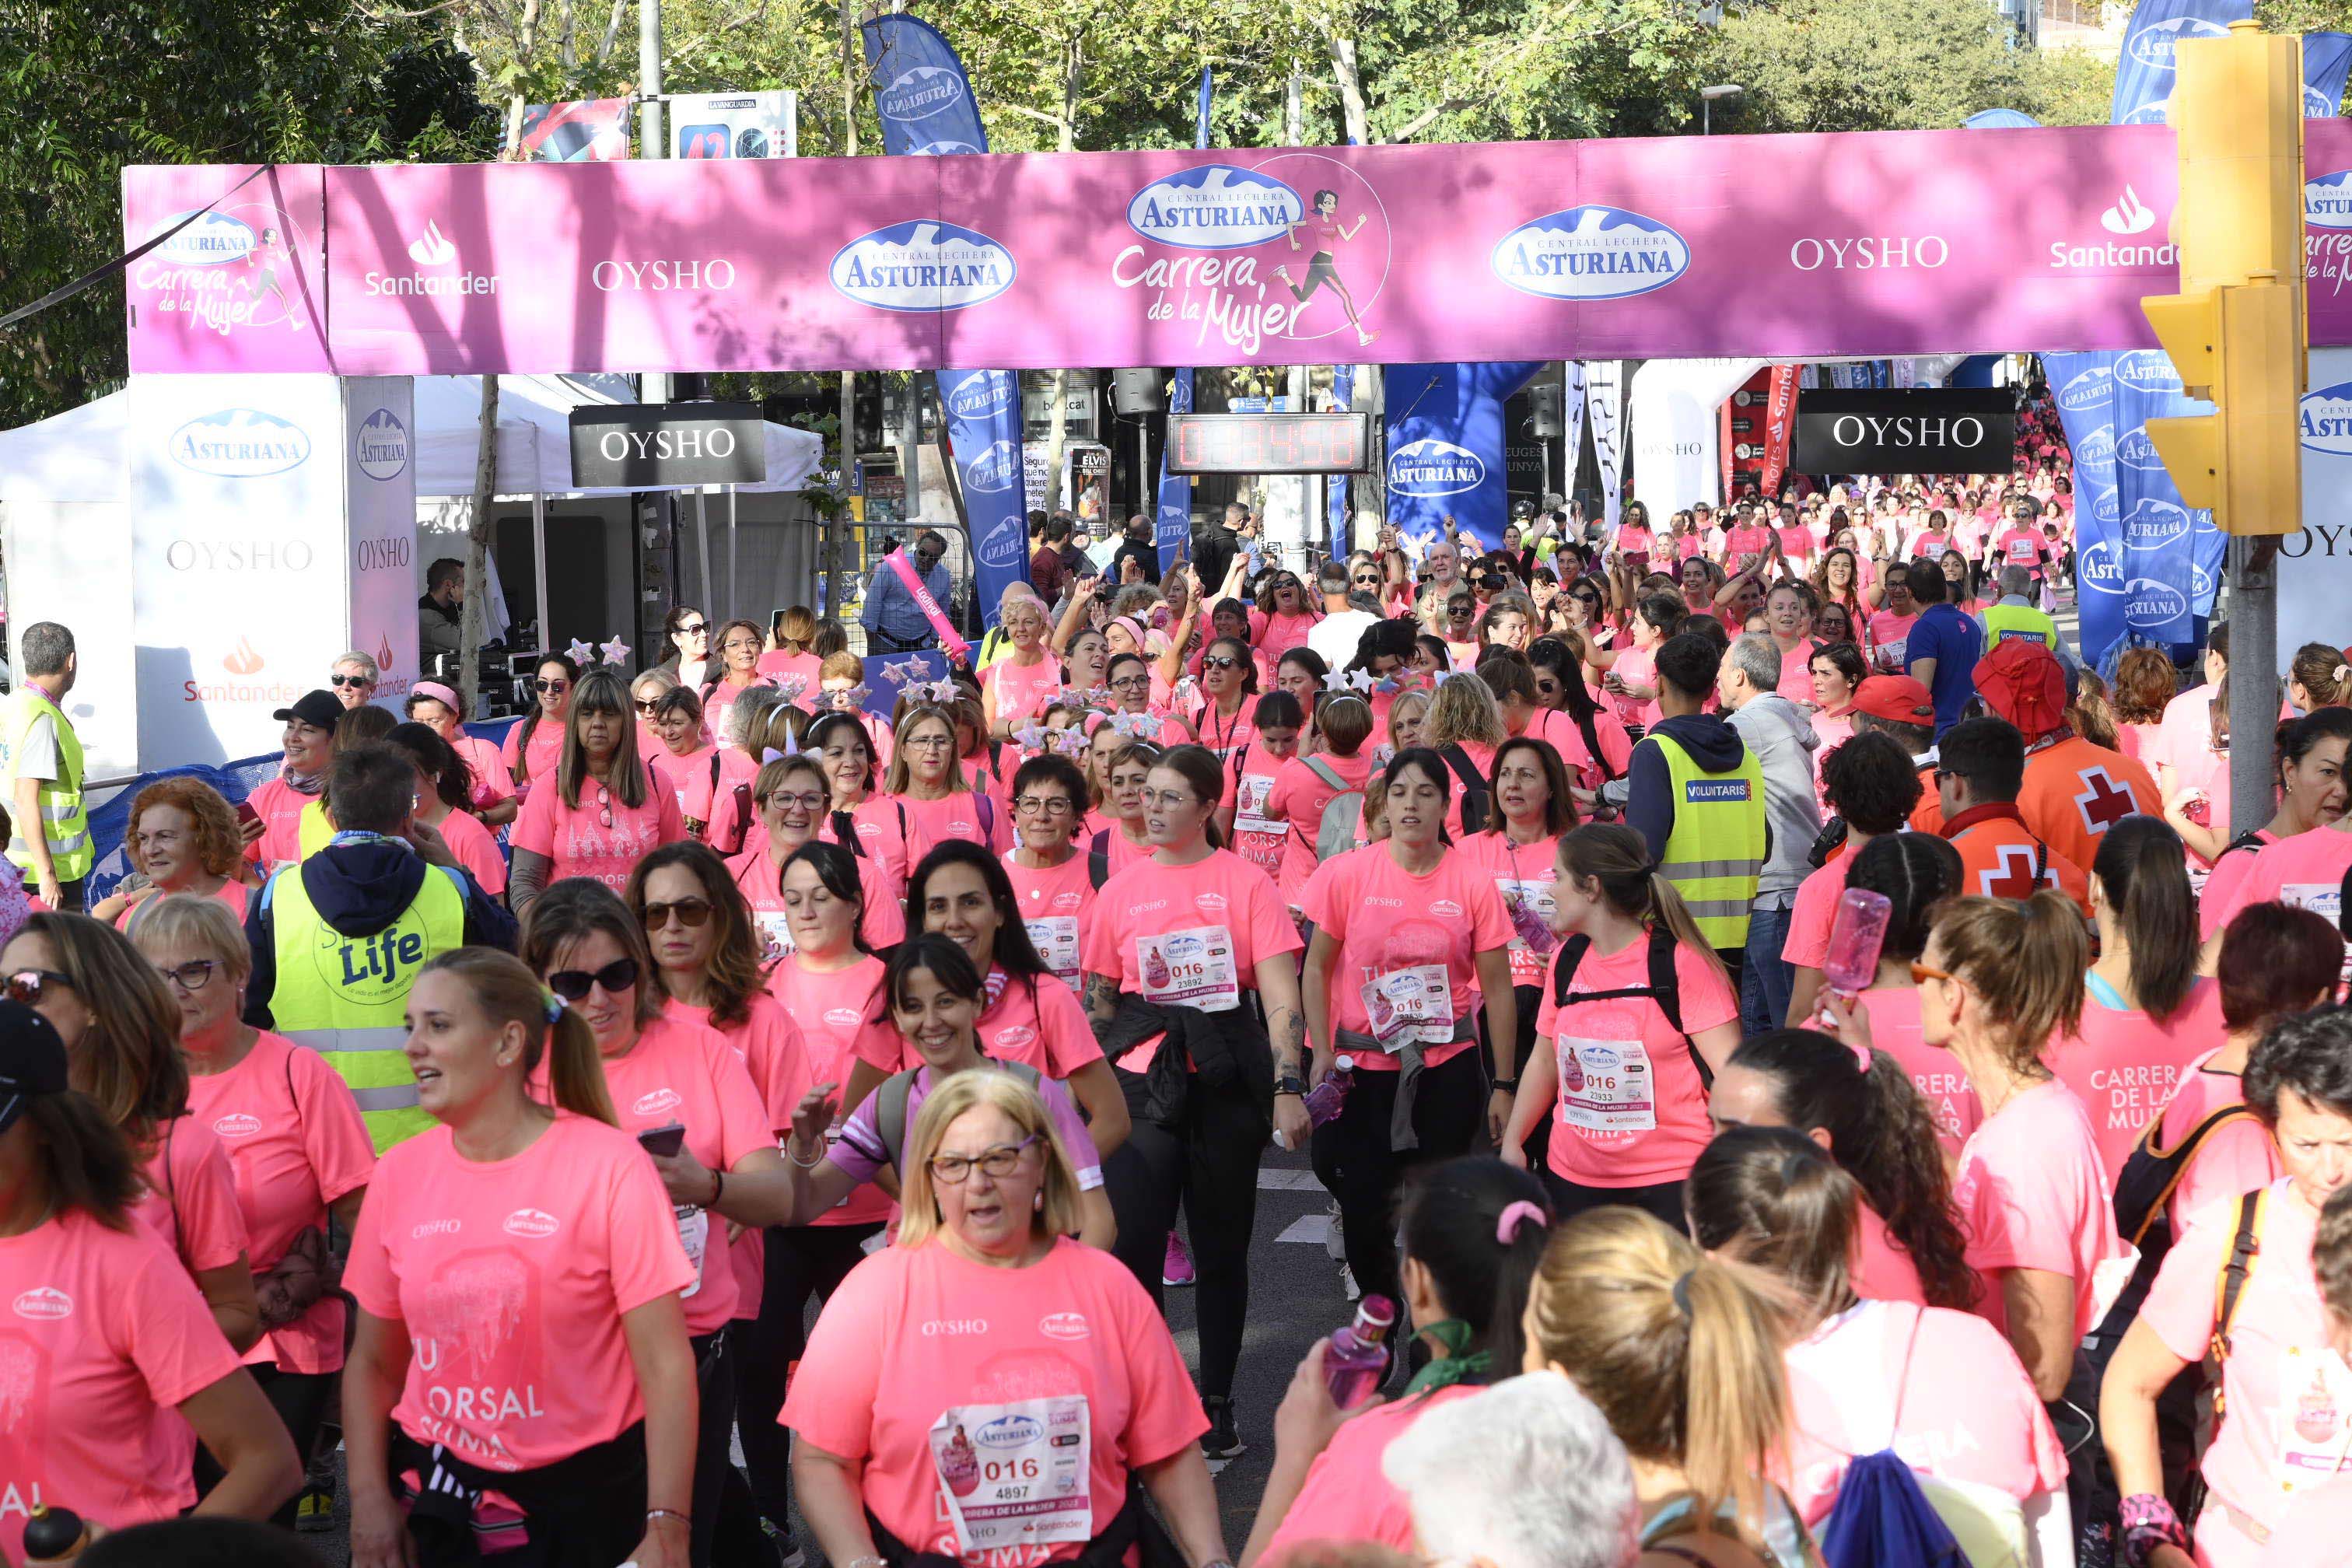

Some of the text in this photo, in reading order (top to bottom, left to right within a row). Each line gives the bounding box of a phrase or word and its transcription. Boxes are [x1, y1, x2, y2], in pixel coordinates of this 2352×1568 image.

[1167, 192, 1285, 203] CENTRAL LECHERA
[1140, 197, 1290, 229] ASTURIANA
[1538, 236, 1668, 249] CENTRAL LECHERA
[872, 249, 996, 263] CENTRAL LECHERA
[1507, 242, 1674, 277] ASTURIANA
[1790, 236, 1948, 271] OYSHO
[136, 261, 228, 290] Carrera
[592, 258, 735, 291] OYSHO
[843, 254, 1003, 289] ASTURIANA
[1112, 245, 1257, 288] Carrera
[2322, 256, 2337, 278] la
[365, 270, 502, 296] Santander
[159, 286, 262, 336] de la Mujer
[1147, 282, 1313, 356] de la Mujer
[1832, 415, 1984, 449] OYSHO
[181, 434, 301, 460] ASTURIANA
[360, 439, 404, 463] ASTURIANA
[600, 427, 735, 461] OYSHO
[1641, 441, 1702, 457] OYSHO
[1082, 456, 1106, 465] ELVIS
[1024, 469, 1038, 478] que
[1390, 463, 1479, 485] ASTURIANA
[166, 540, 313, 572] OYSHO
[358, 536, 410, 572] OYSHO
[915, 586, 941, 617] Ladival
[184, 681, 304, 704] Santander
[1686, 785, 1746, 798] VOLUNTARIS
[1240, 846, 1278, 865] SUMA
[1129, 899, 1167, 916] OYSHO
[1364, 897, 1404, 908] OYSHO
[338, 928, 423, 986] Life
[1167, 943, 1202, 955] ASTURIANA
[1171, 963, 1203, 978] 016
[1178, 978, 1202, 989] 23892
[1389, 981, 1421, 994] ASTURIANA
[1397, 999, 1423, 1013] 016
[1582, 1053, 1617, 1065] ASTURIANA
[1587, 1075, 1616, 1090] 016
[1590, 1090, 1613, 1102] 23933
[2111, 1085, 2173, 1108] DE LA
[921, 1319, 989, 1336] OYSHO
[981, 1426, 1040, 1444] ASTURIANA
[985, 1458, 1039, 1481] 016
[996, 1486, 1030, 1500] 4897
[997, 1506, 1010, 1516] DE
[1011, 1504, 1024, 1515] LA
[1024, 1502, 1055, 1514] MUJER
[1035, 1519, 1083, 1533] Santander
